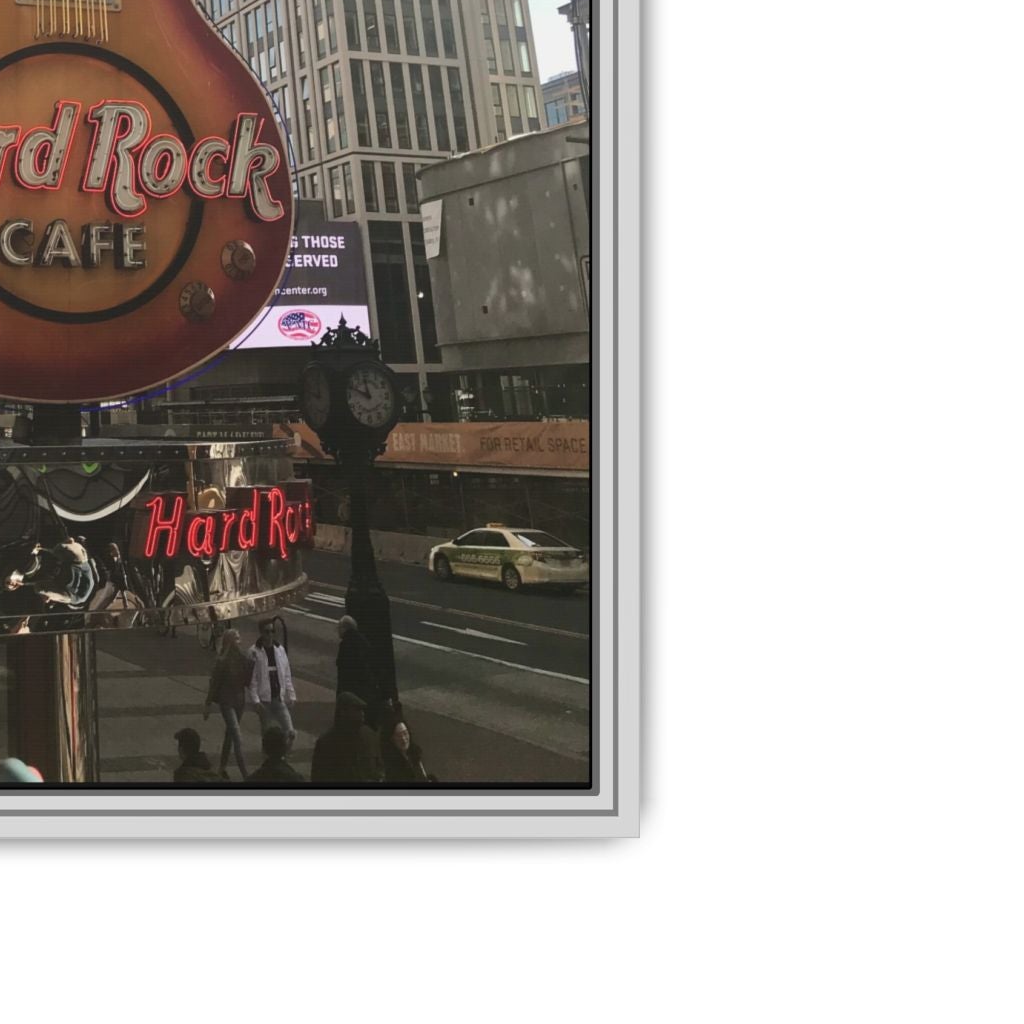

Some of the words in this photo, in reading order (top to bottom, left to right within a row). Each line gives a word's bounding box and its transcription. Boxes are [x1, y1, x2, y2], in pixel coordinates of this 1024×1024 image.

[82, 99, 285, 222] Rock
[301, 236, 345, 249] THOSE
[392, 432, 416, 451] EAST
[480, 437, 502, 451] FOR
[504, 437, 543, 453] RETAIL
[547, 438, 587, 454] SPACE
[144, 487, 259, 558] Hard
[267, 487, 313, 561] Ro
